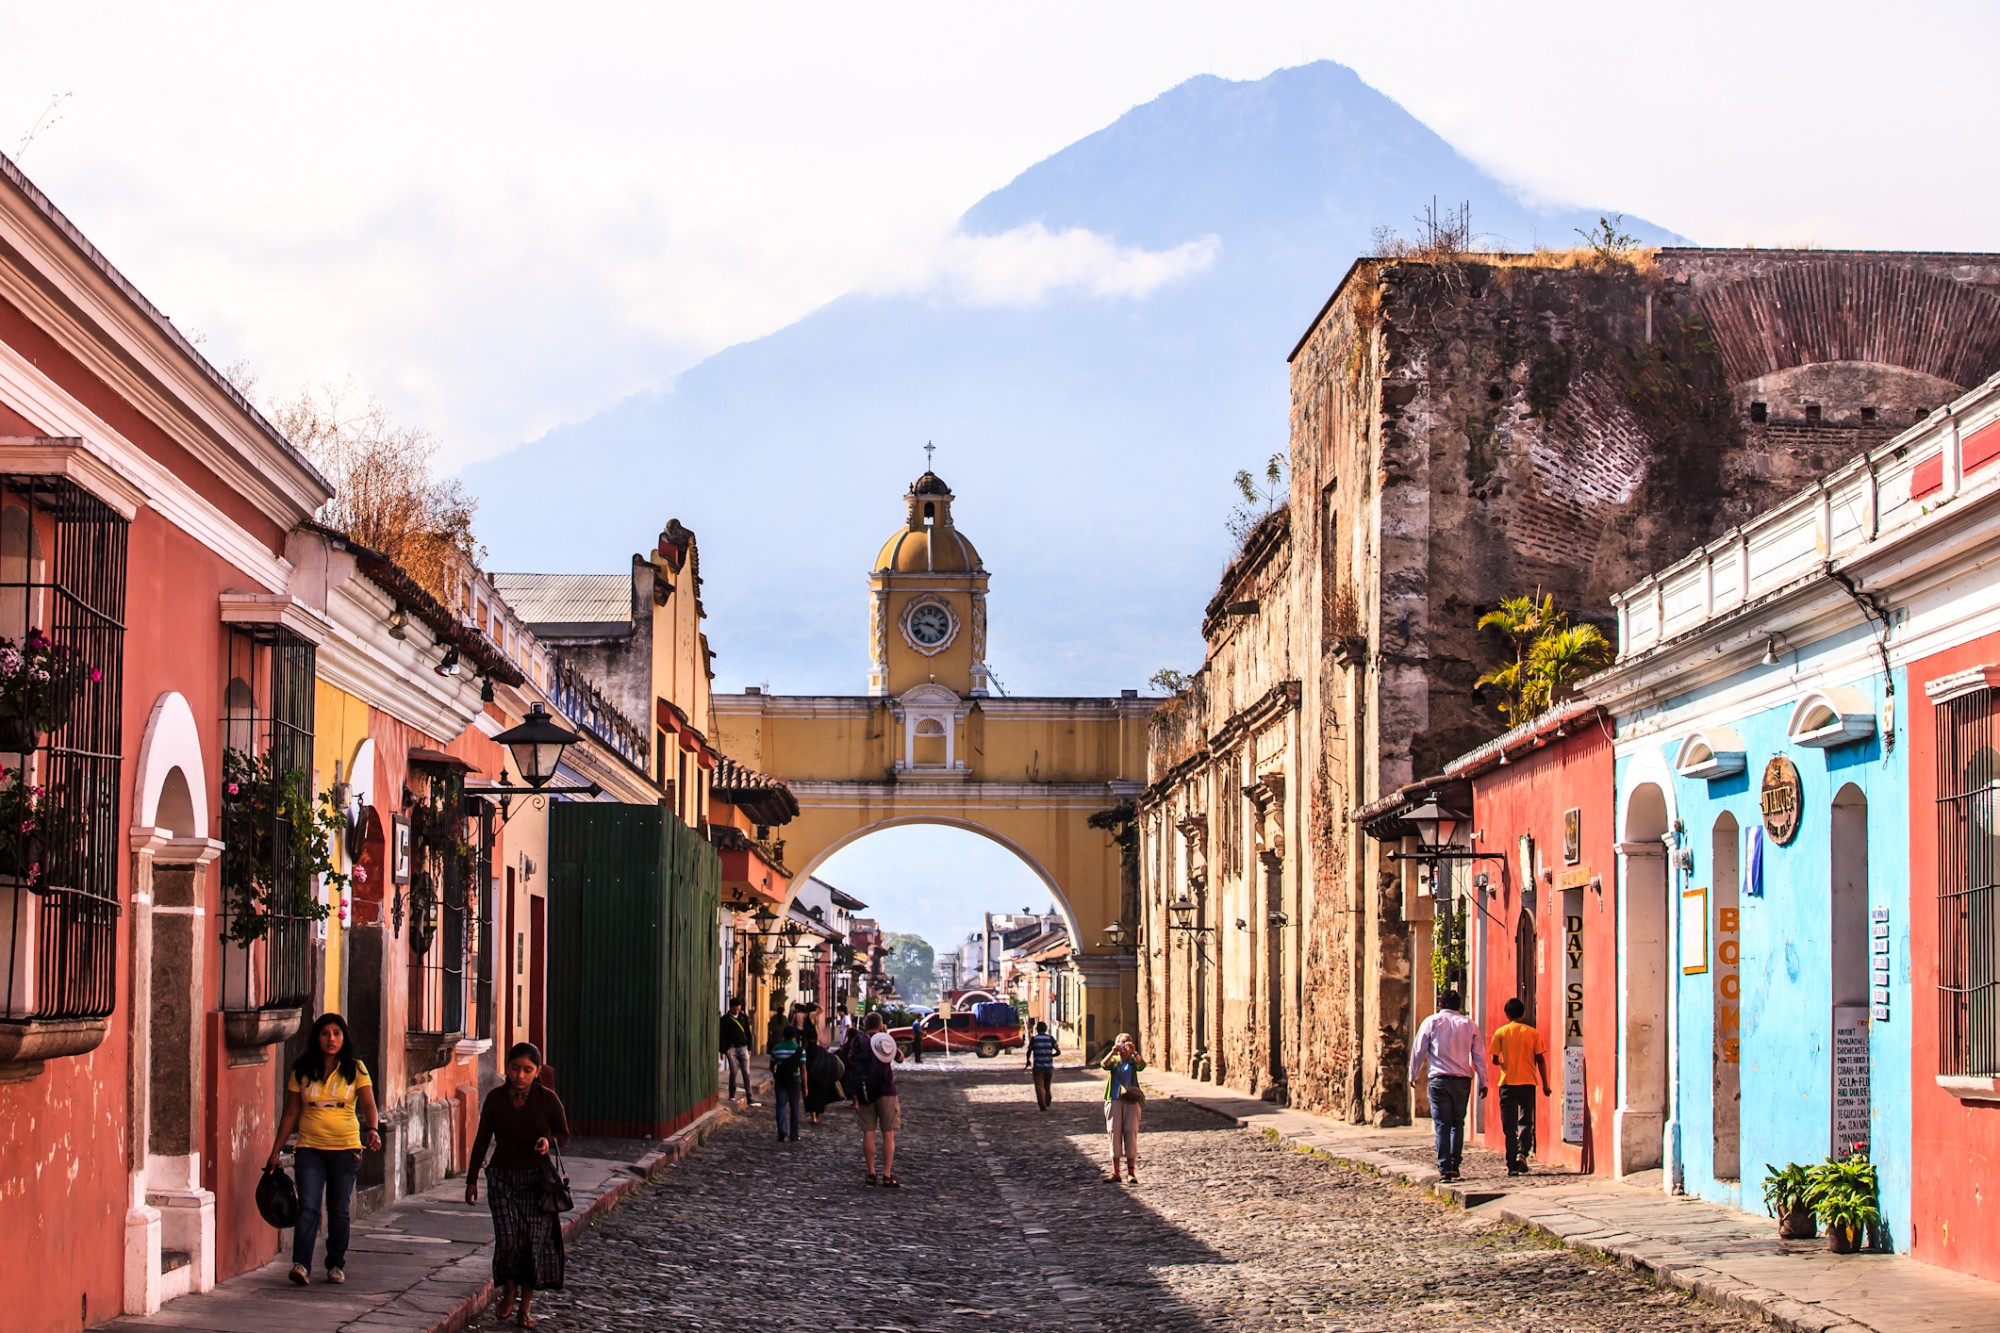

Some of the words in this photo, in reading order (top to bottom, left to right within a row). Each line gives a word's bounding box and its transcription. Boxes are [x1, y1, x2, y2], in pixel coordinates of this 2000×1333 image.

[1567, 916, 1583, 969] DAY
[1567, 983, 1583, 1037] SPA
[1719, 908, 1740, 1063] BOOKS
